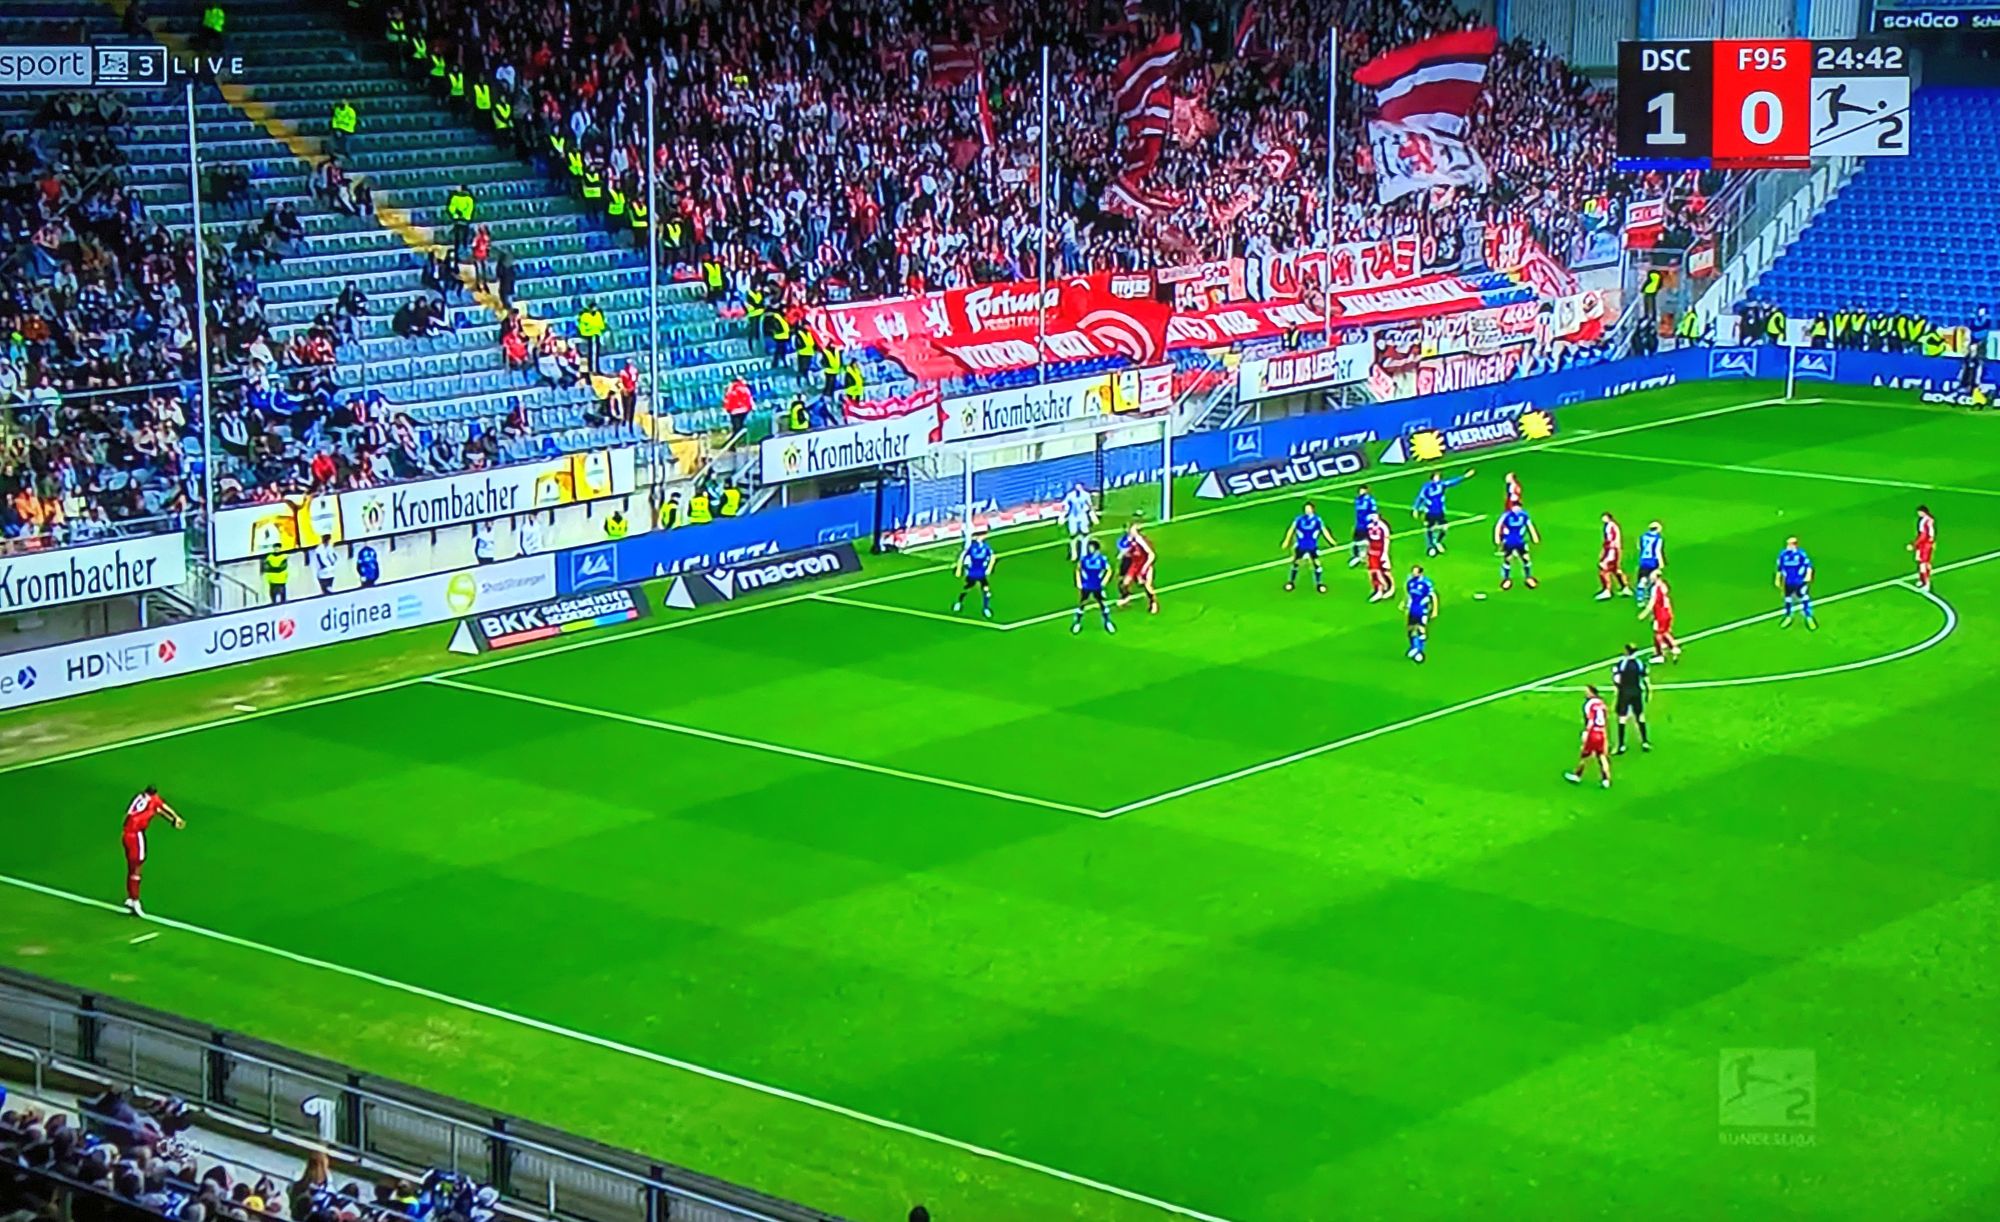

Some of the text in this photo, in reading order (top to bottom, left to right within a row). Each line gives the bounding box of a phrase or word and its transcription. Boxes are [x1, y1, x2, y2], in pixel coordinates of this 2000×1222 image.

[964, 286, 1060, 334] Fortuna
[982, 390, 1072, 432] Krombacher
[807, 423, 910, 473] Krombacher
[1446, 420, 1517, 448] MERKUR
[1227, 453, 1361, 494] SCHÜCO
[392, 478, 519, 531] Krombacher
[0, 549, 157, 608] Krombacher
[736, 553, 841, 590] macron
[204, 621, 277, 655] JOBRI
[320, 603, 392, 633] diginea
[480, 608, 543, 638] BKK
[66, 643, 155, 682] HDNET
